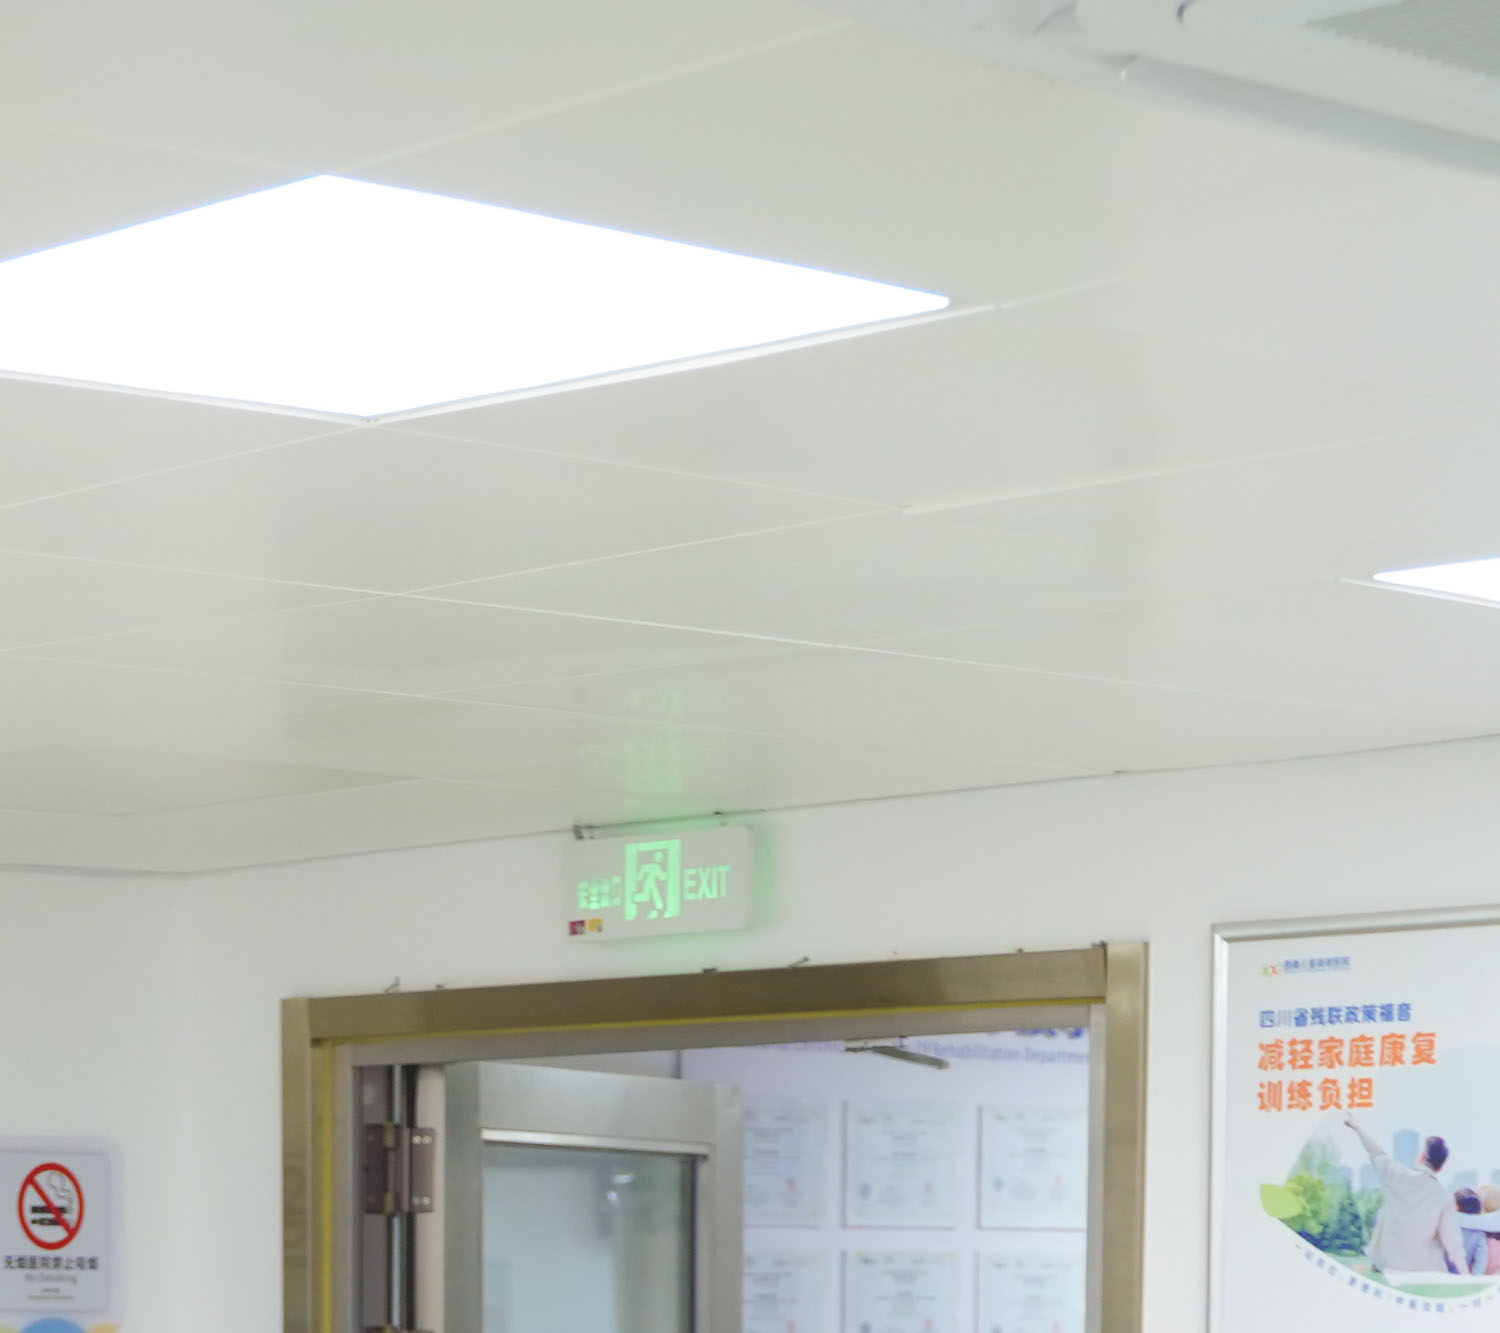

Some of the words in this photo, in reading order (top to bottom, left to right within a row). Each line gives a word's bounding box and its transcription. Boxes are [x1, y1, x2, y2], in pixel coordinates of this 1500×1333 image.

[684, 865, 731, 901] EXIT
[1257, 1032, 1438, 1072] 减轻家庭康复
[1257, 1076, 1375, 1113] 训练负担
[3, 1255, 99, 1271] 无烟医院禁止吸烟
